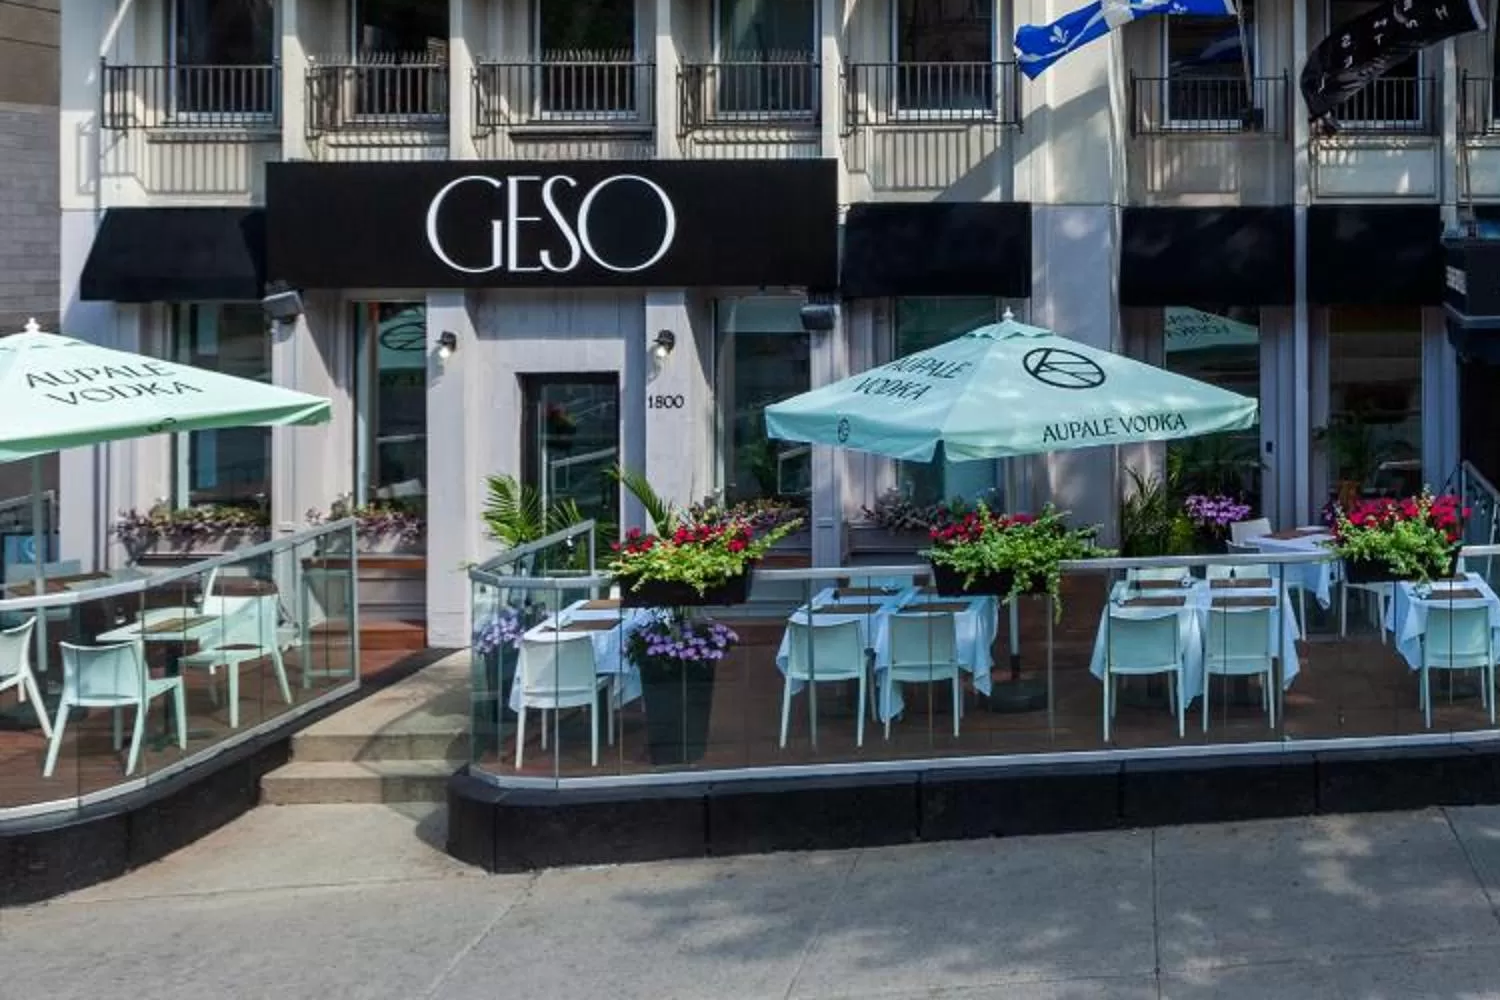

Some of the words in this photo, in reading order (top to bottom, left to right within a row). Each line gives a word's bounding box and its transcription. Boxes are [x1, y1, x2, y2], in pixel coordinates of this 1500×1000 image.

[426, 173, 676, 273] GESO
[25, 361, 176, 389] AUPALE
[883, 356, 973, 379] AUPALE
[46, 381, 205, 406] VODKA
[853, 376, 933, 401] VODKA
[648, 394, 685, 409] 1800
[1042, 417, 1117, 443] AUPALE
[1119, 412, 1188, 434] VODKA
